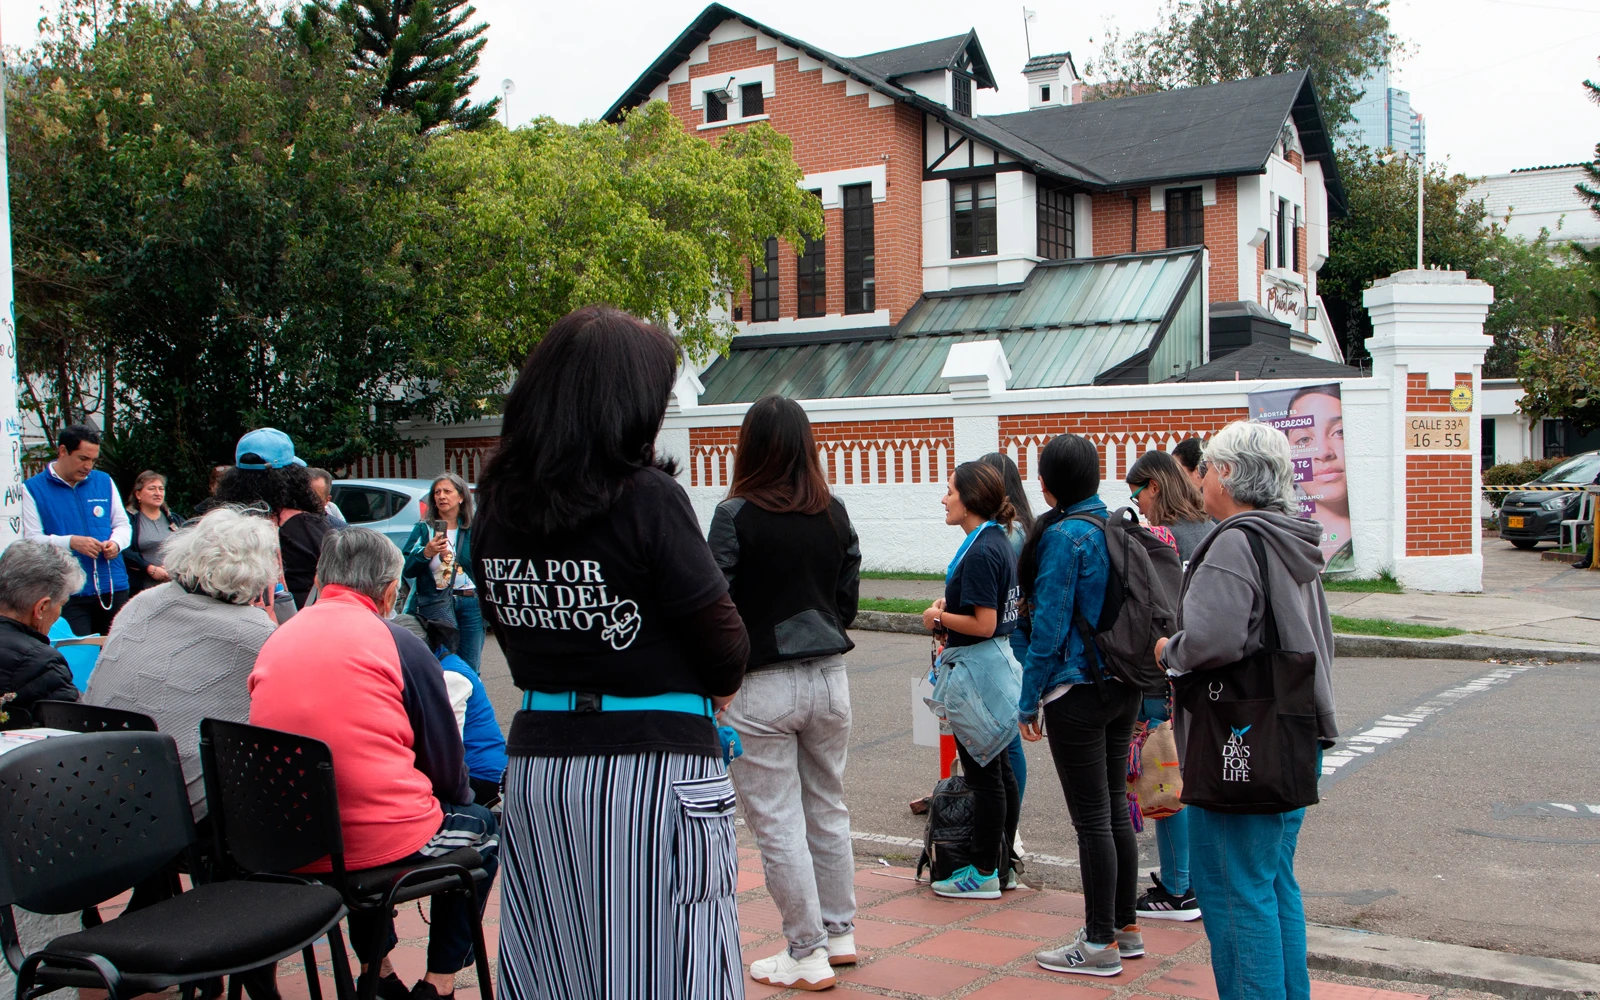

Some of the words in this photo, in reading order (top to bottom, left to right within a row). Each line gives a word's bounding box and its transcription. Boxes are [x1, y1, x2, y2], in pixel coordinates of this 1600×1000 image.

[1275, 418, 1312, 429] DERECHO
[1411, 419, 1441, 430] CALLE
[1413, 433, 1430, 447] 16
[1444, 433, 1461, 447] 55
[482, 559, 540, 581] REZA
[545, 559, 604, 583] POR
[504, 583, 548, 607] FIN
[554, 585, 619, 609] DEL
[1227, 732, 1243, 747] 40
[1222, 745, 1251, 757] DAYS
[1224, 757, 1251, 770] FOR
[1223, 769, 1250, 782] LIFE
